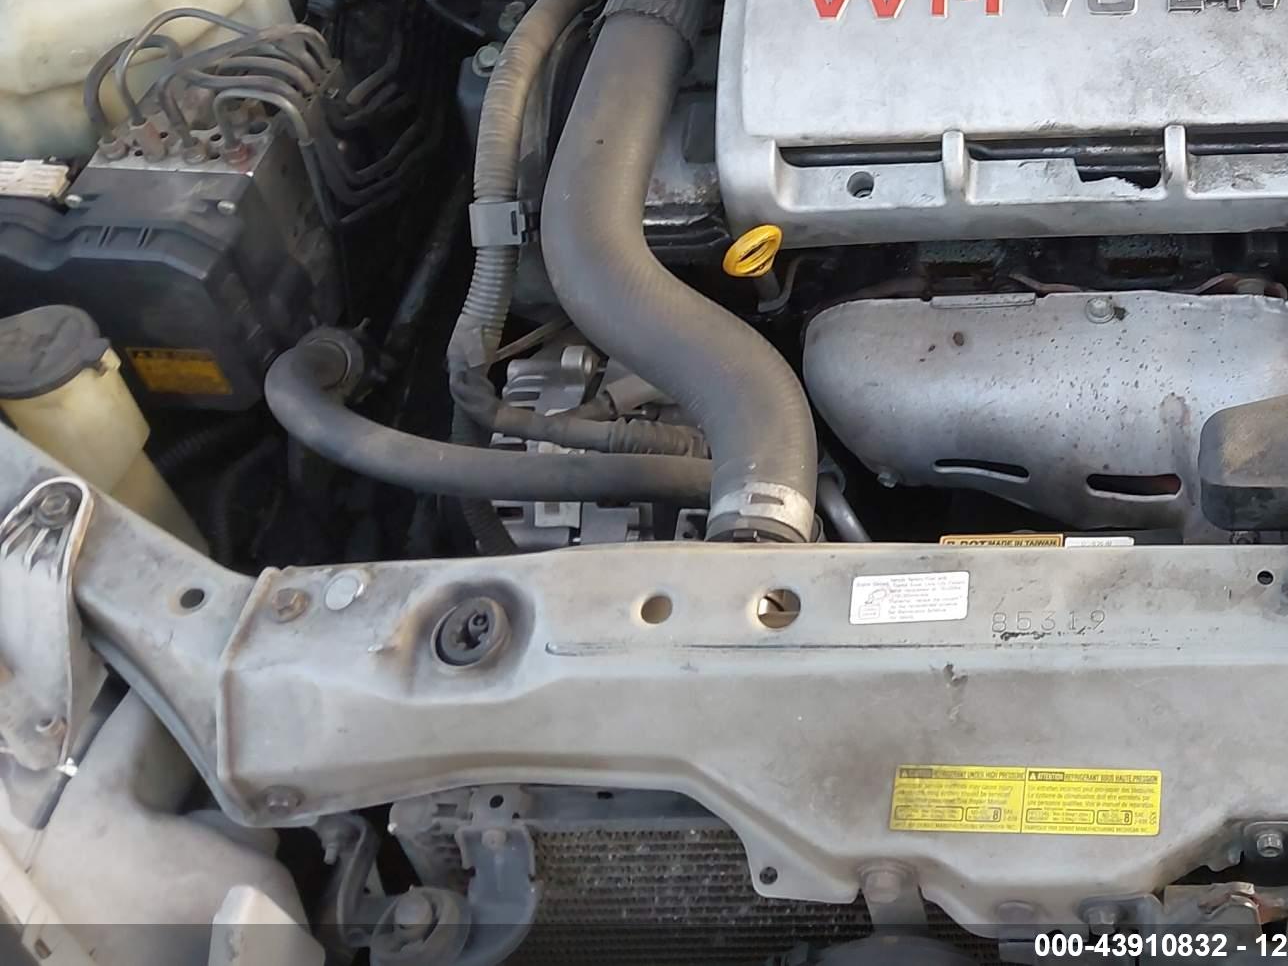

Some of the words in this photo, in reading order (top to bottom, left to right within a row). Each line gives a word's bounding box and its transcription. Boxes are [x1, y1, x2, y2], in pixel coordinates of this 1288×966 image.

[991, 609, 1106, 633] 85319
[992, 809, 999, 820] 8
[1122, 812, 1130, 823] 8
